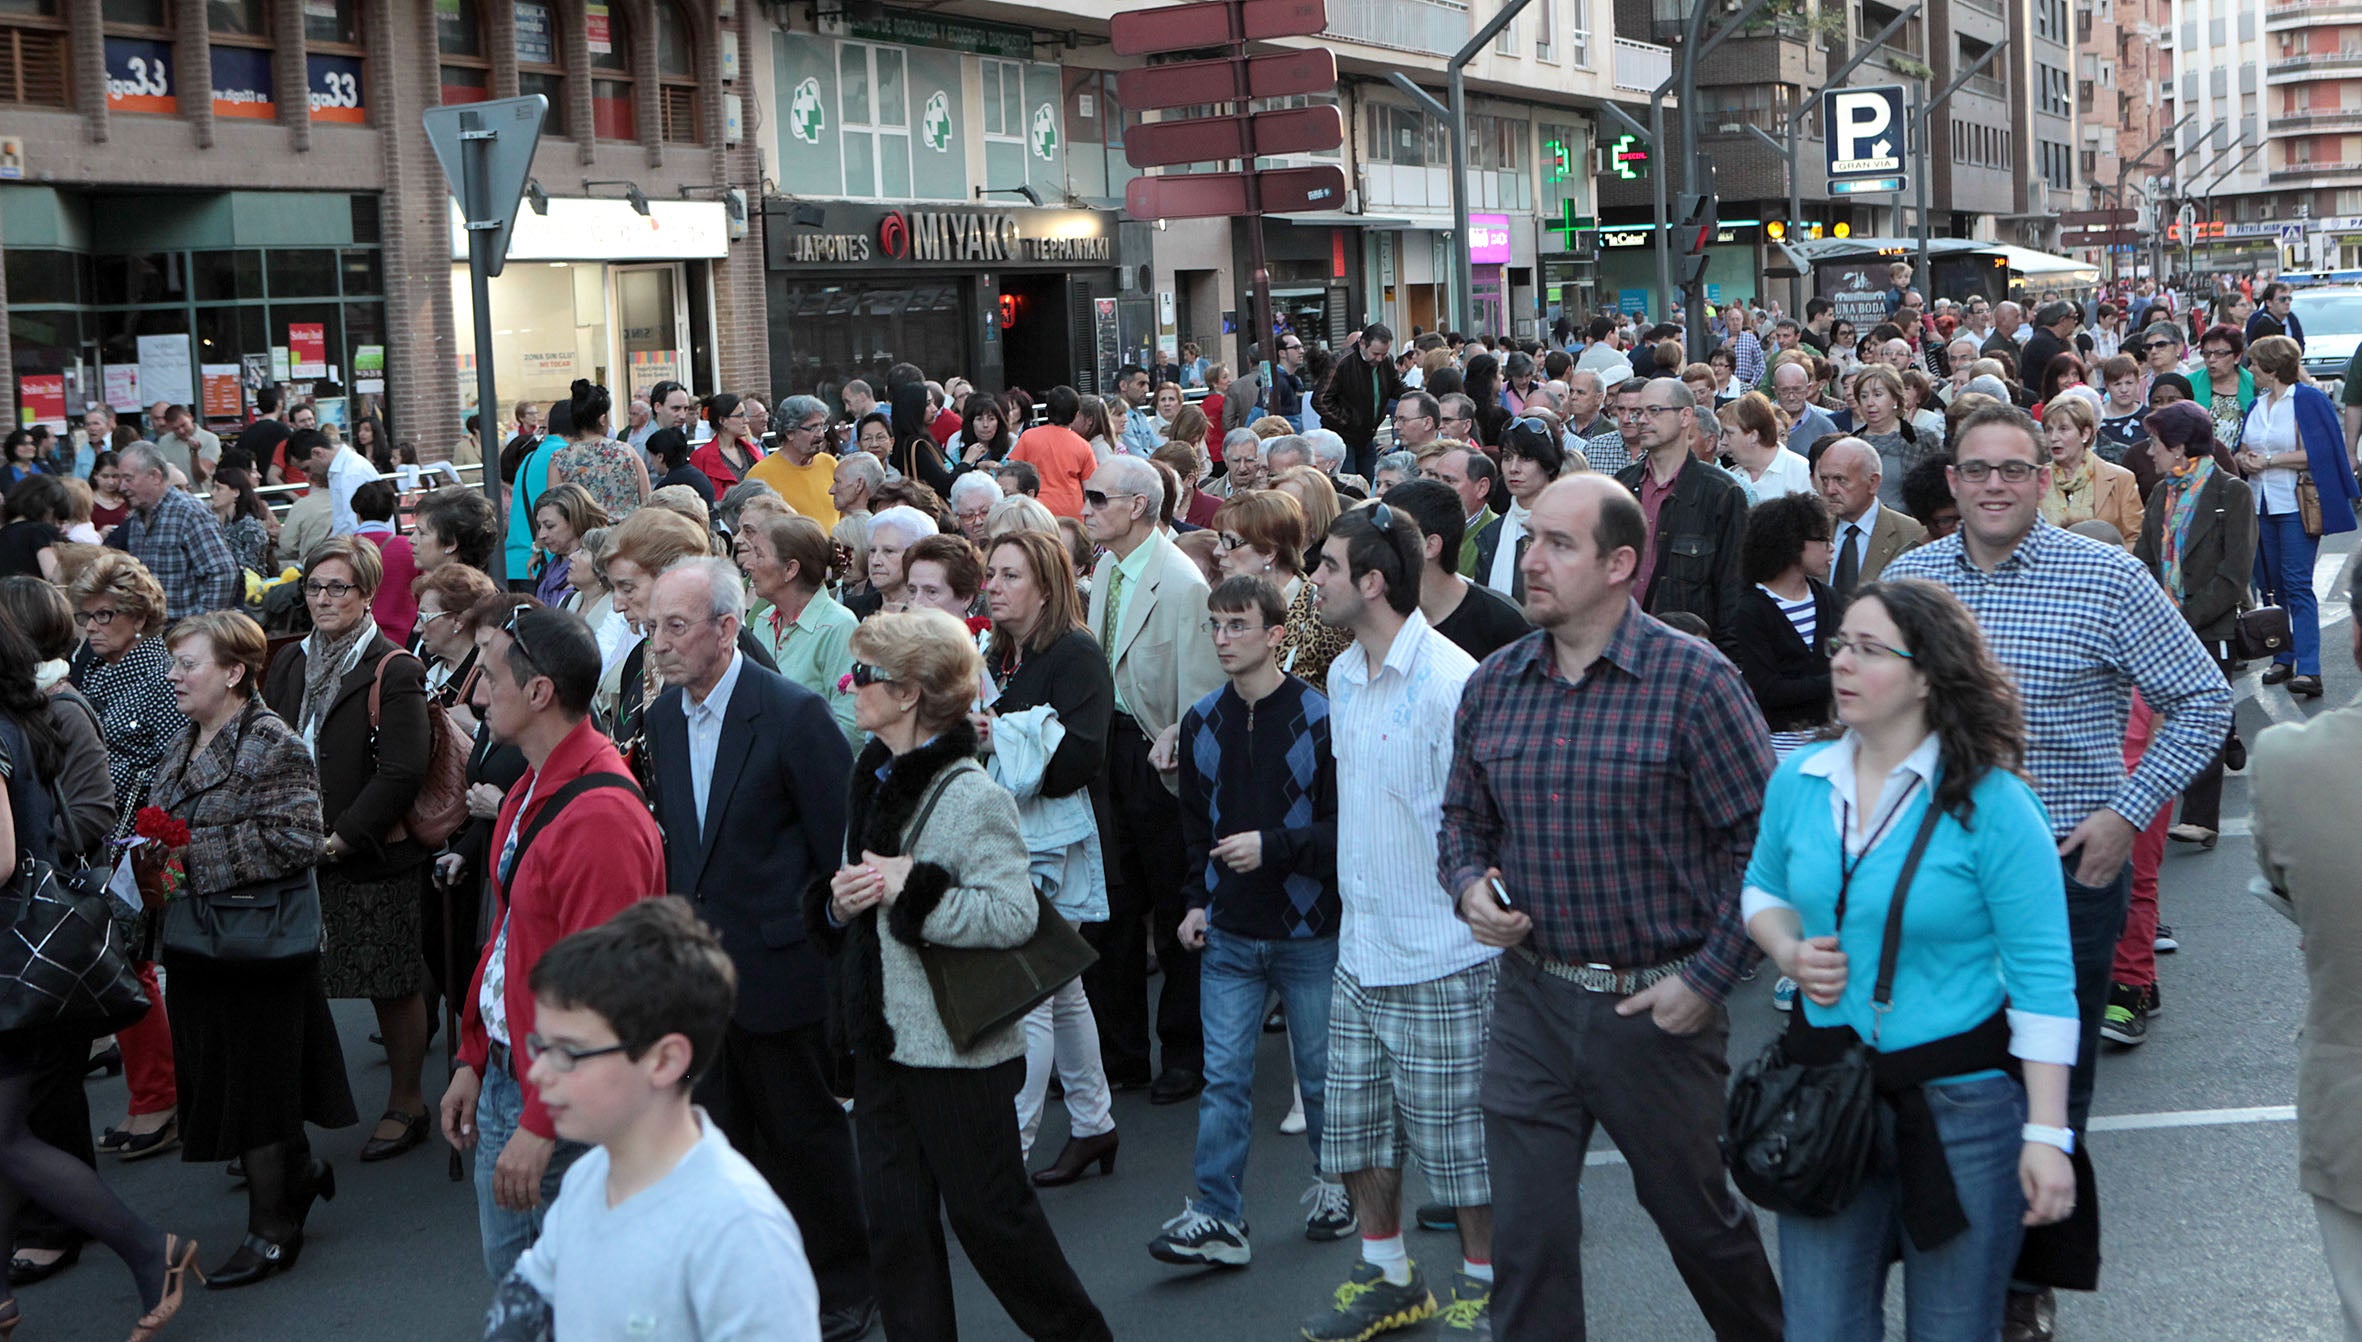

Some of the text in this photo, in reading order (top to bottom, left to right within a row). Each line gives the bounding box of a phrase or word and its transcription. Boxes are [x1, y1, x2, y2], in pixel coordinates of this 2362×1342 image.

[1836, 92, 1891, 160] P
[1838, 162, 1870, 170] GRAN
[795, 211, 1109, 262] JAPONES MIYAKO TEPPANYAKI
[1835, 302, 1886, 315] UNA BODA
[1860, 313, 1883, 322] BODEG
